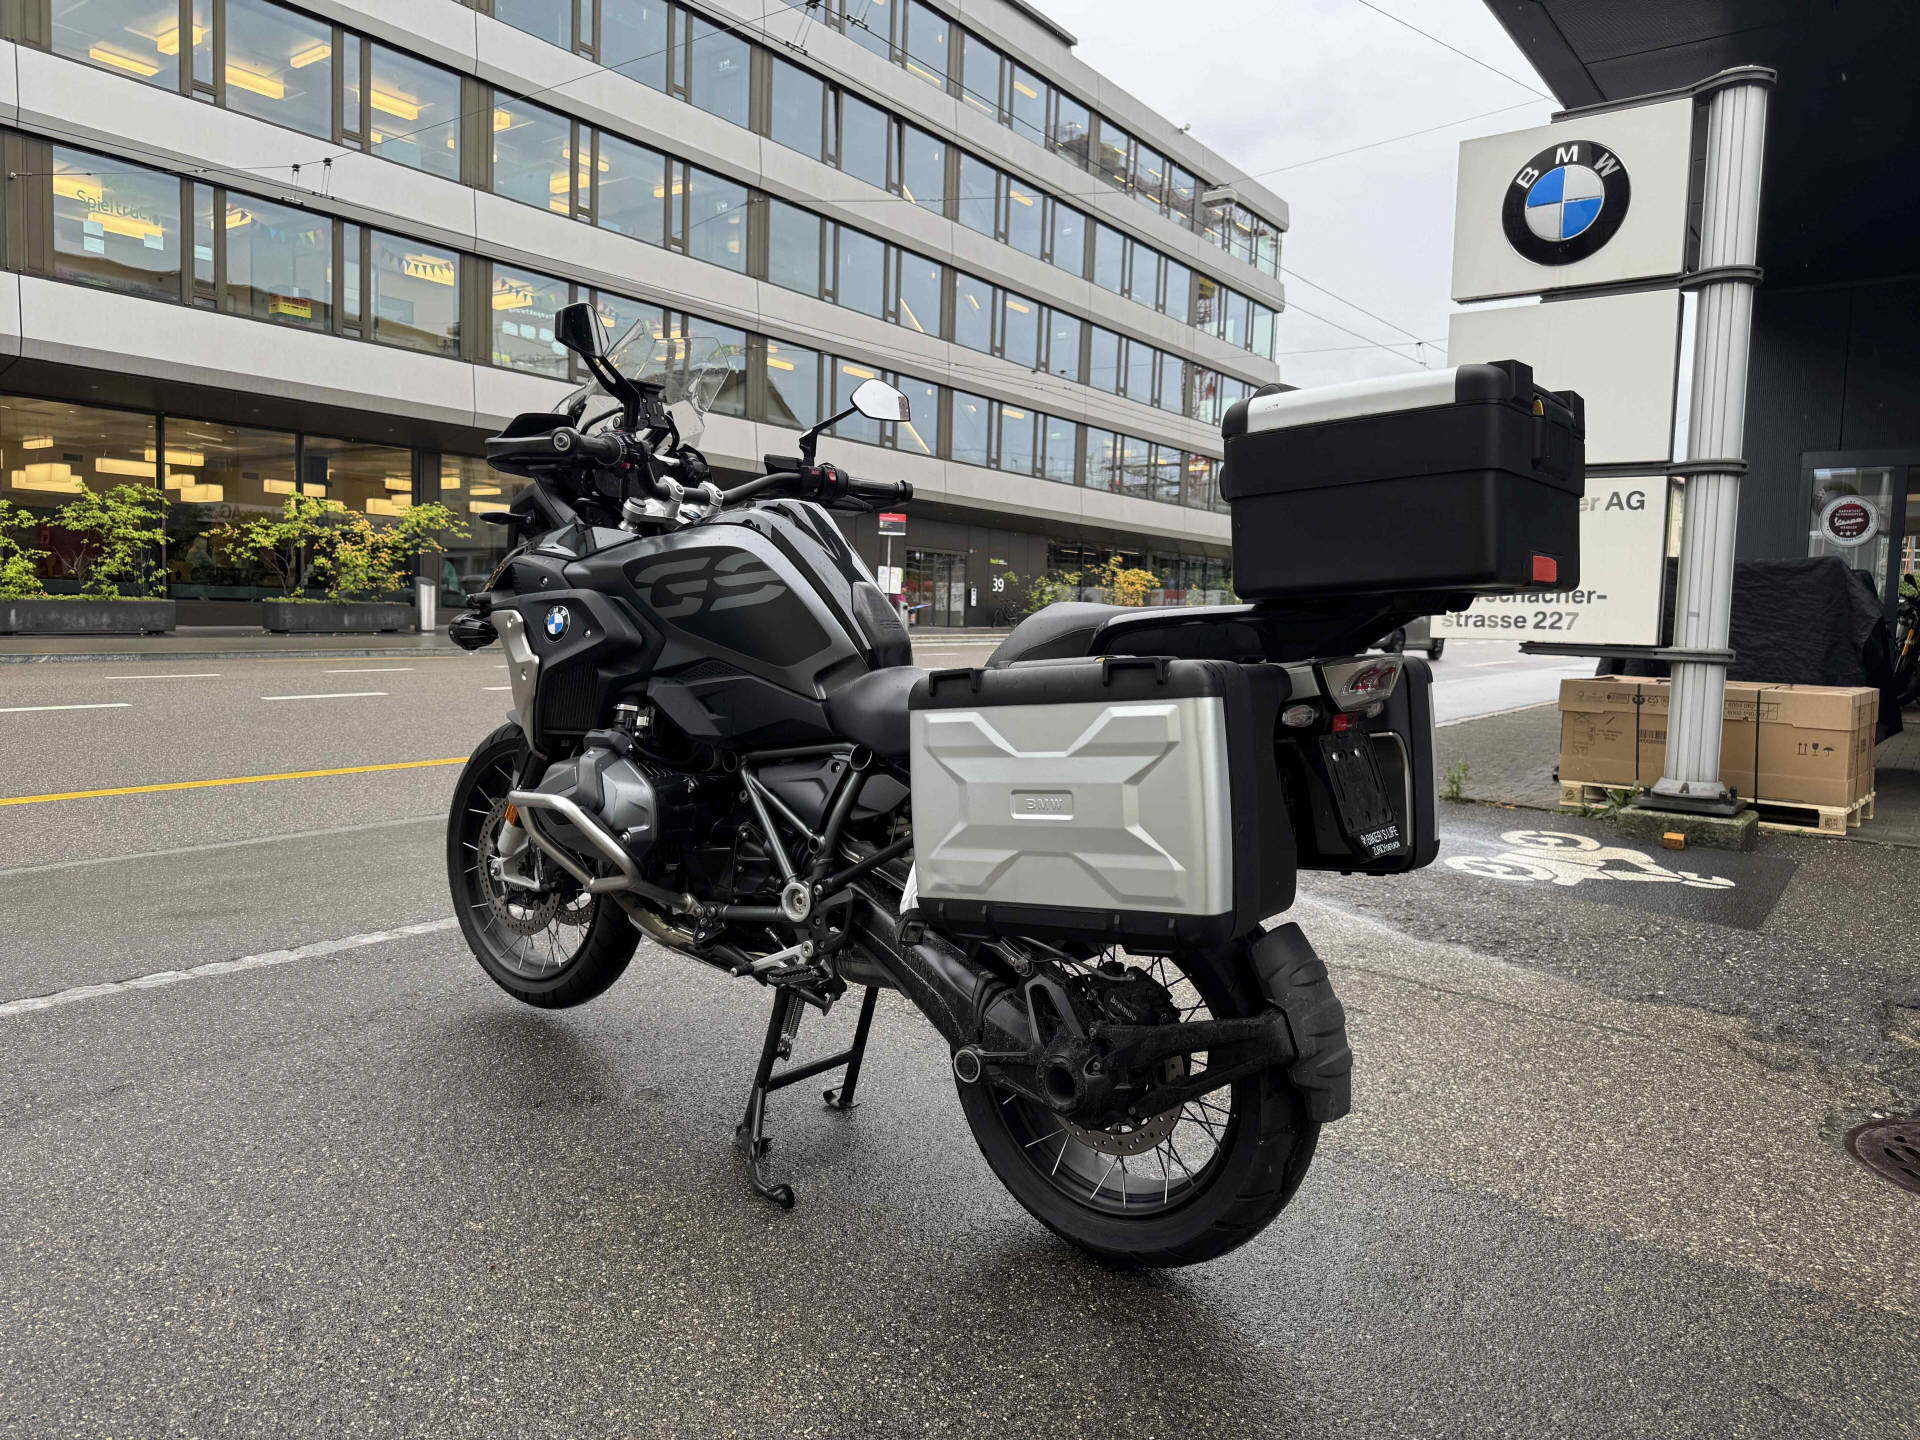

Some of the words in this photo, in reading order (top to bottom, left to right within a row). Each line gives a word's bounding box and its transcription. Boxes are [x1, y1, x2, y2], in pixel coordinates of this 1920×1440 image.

[1515, 144, 1620, 189] BMW
[1604, 490, 1646, 511] AG
[634, 551, 788, 618] GS
[991, 578, 1005, 592] 39
[1441, 612, 1527, 629] strasse
[1532, 610, 1580, 630] 227
[1025, 798, 1064, 810] BMW
